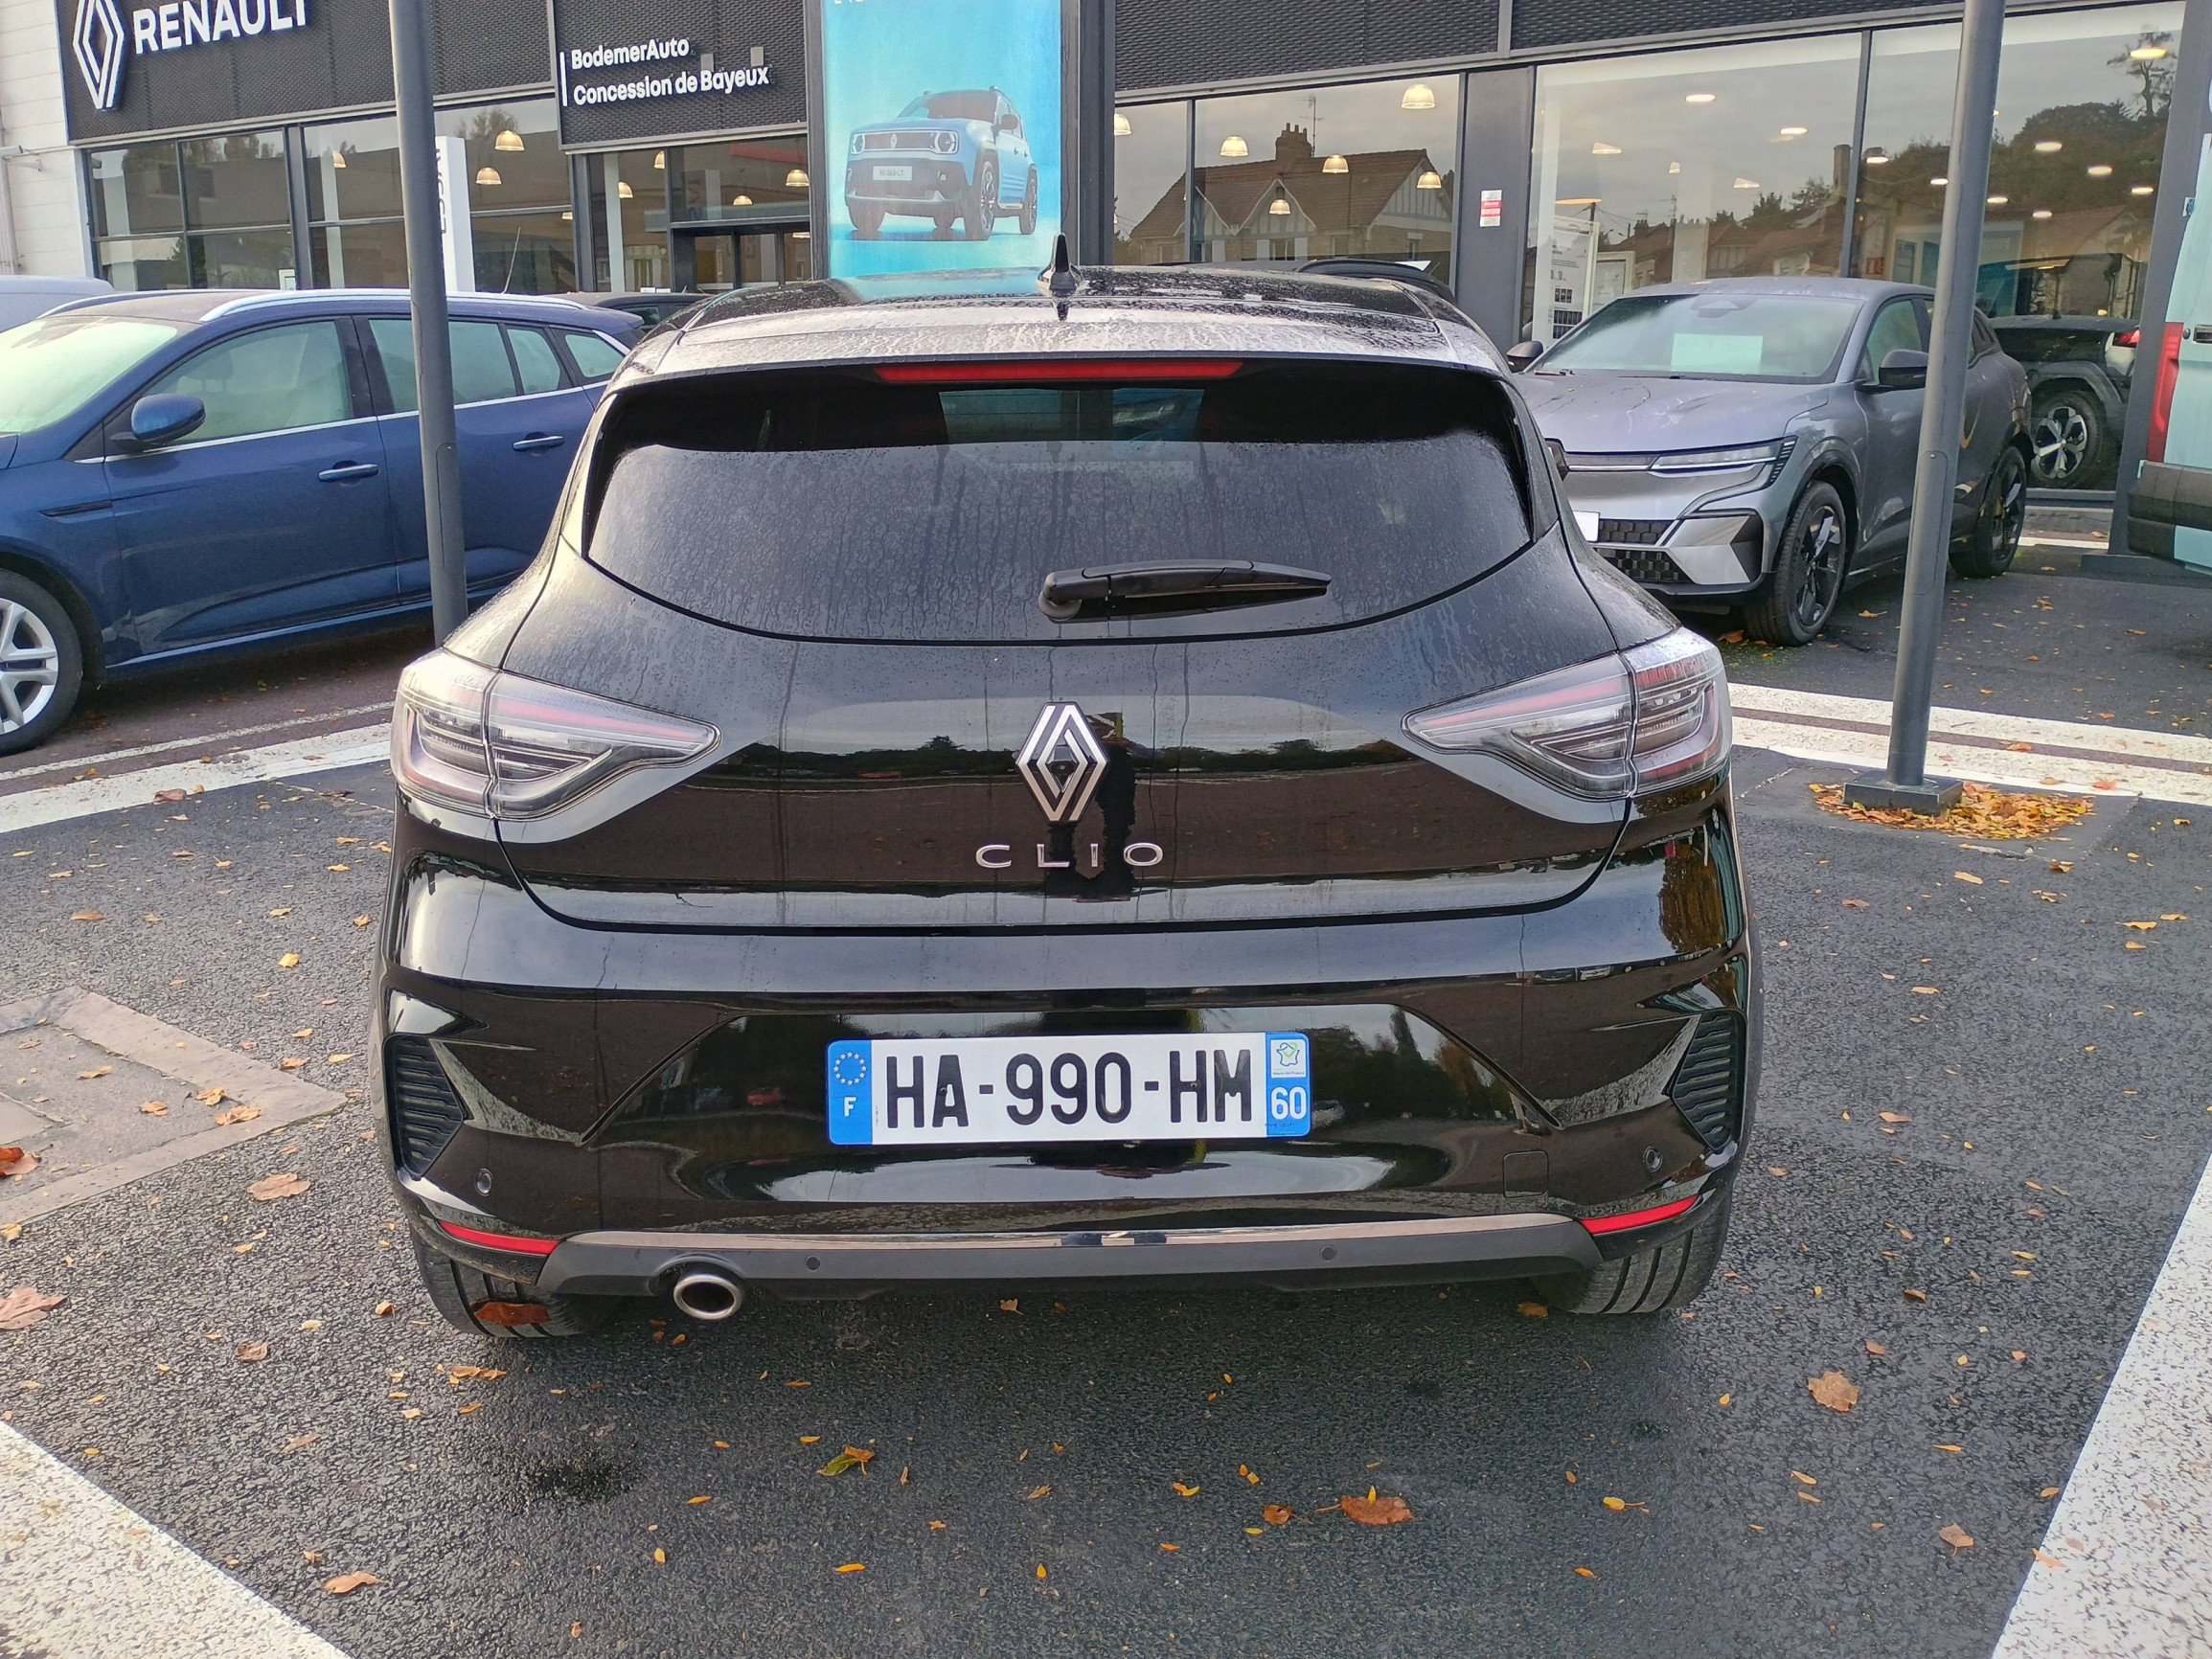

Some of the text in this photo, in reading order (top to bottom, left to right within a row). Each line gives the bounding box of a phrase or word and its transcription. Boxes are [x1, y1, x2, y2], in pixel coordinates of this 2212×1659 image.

[571, 37, 690, 69] BodemerAuto
[574, 67, 770, 105] Concession de Bayeux
[975, 842, 1164, 869] CLIO
[886, 1049, 1252, 1128] HA-990-HM
[1271, 1086, 1307, 1120] 60
[844, 1096, 857, 1117] F
